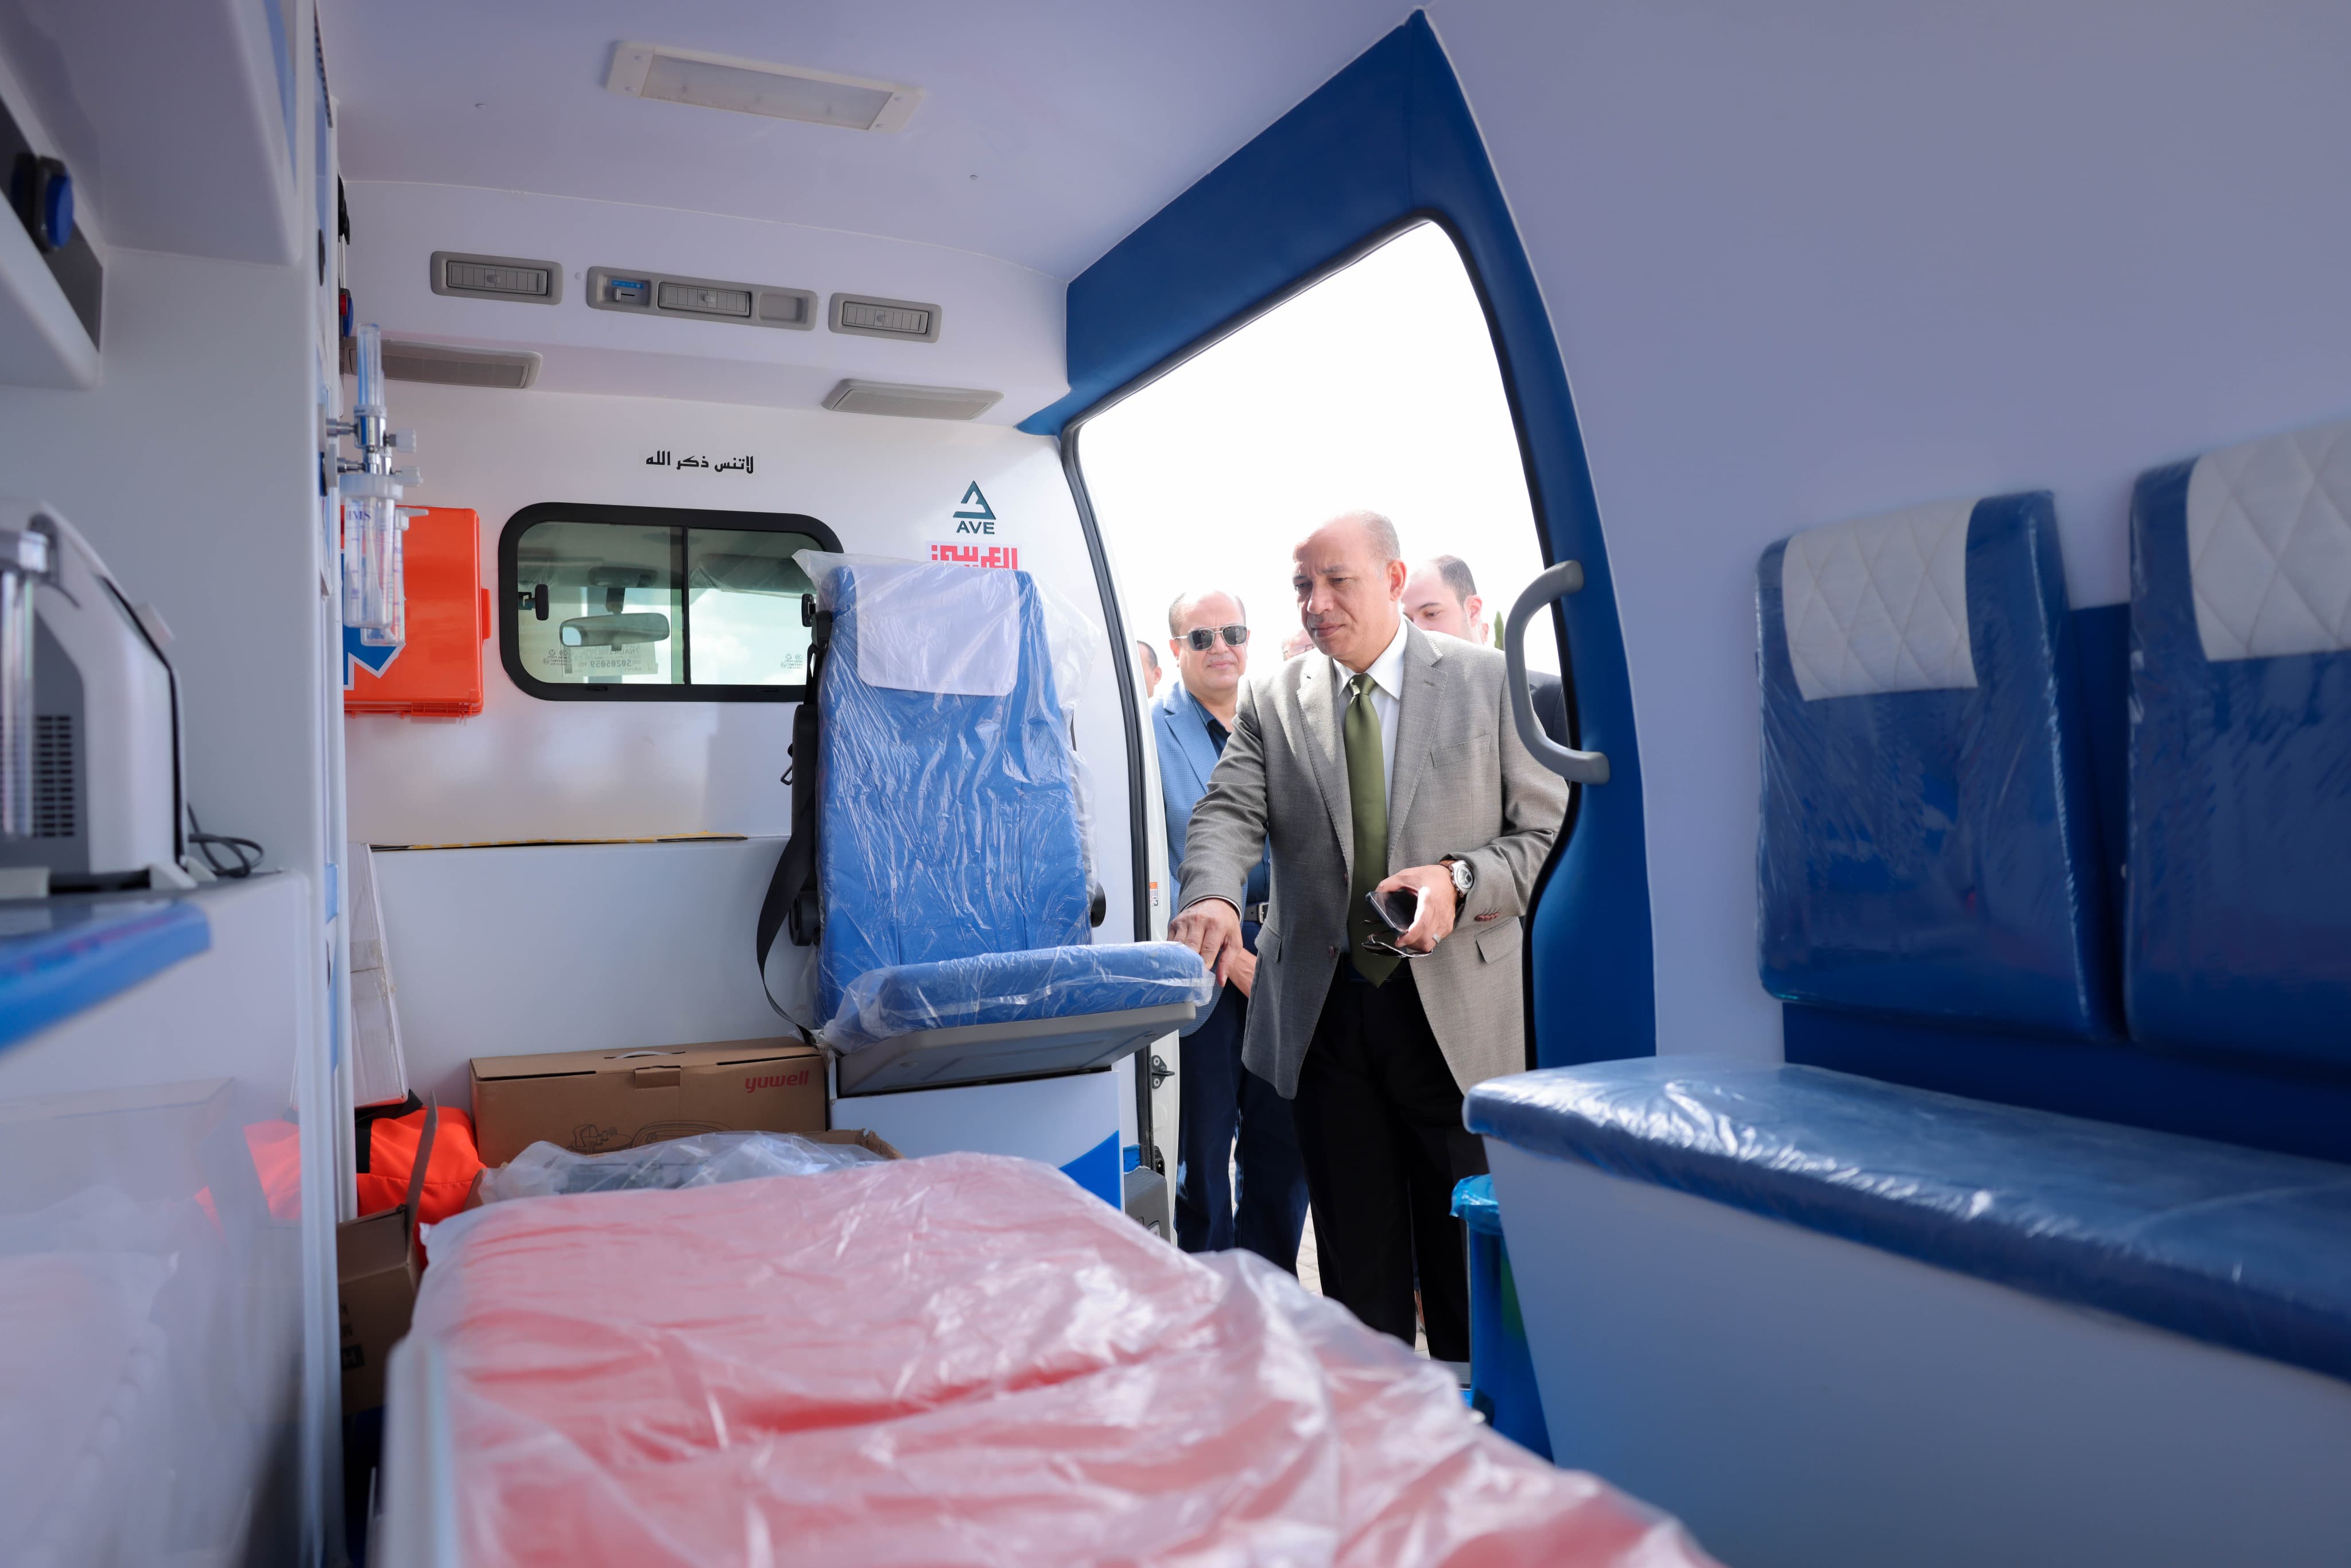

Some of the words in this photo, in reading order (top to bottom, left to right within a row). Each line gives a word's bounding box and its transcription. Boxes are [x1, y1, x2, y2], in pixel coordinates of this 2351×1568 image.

[646, 450, 670, 465] الله
[676, 456, 709, 470] ذكر
[956, 521, 995, 534] AVE
[745, 1070, 809, 1093] yuwell
